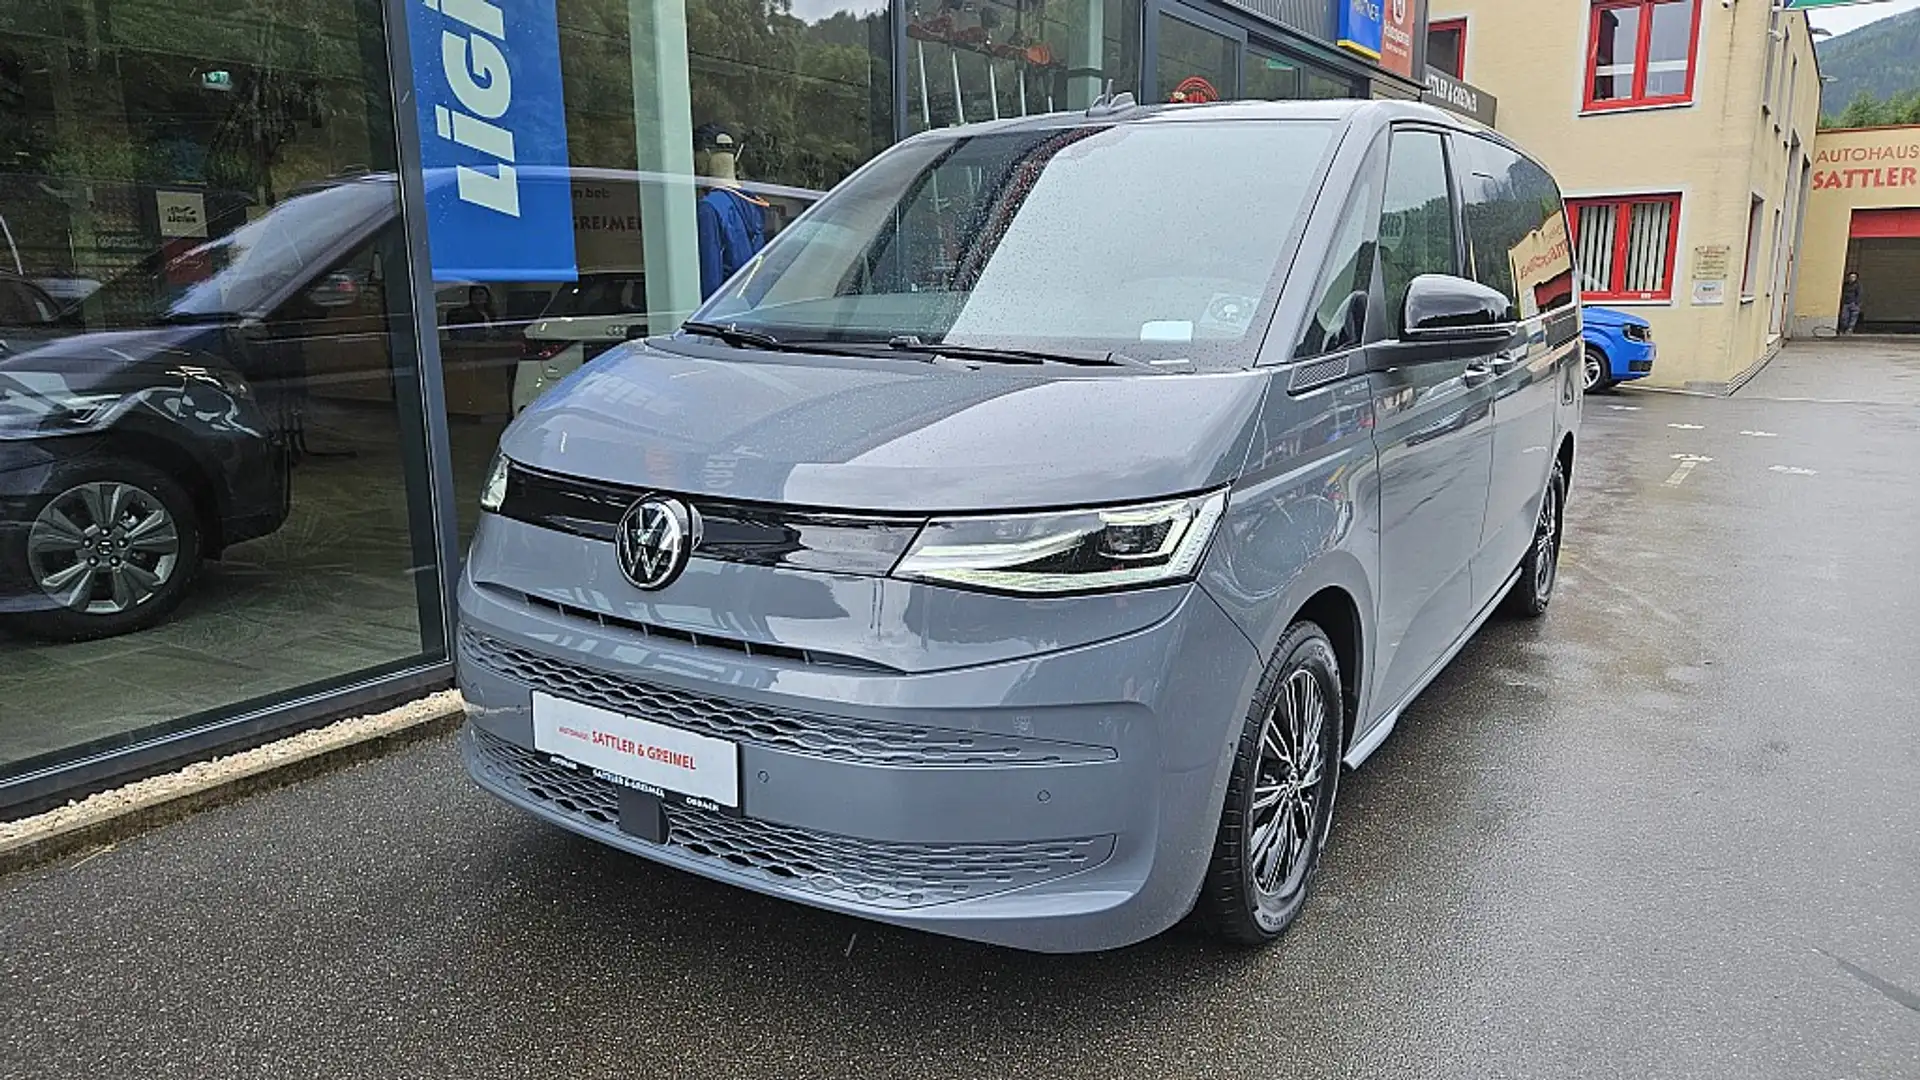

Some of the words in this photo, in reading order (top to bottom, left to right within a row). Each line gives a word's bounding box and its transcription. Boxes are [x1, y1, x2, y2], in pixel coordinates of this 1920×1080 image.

[1816, 144, 1920, 164] AUTOHAUS
[1813, 166, 1917, 190] SATTLER
[592, 730, 635, 755] SATTLER
[637, 744, 645, 757] &
[647, 746, 697, 770] GREIMEL
